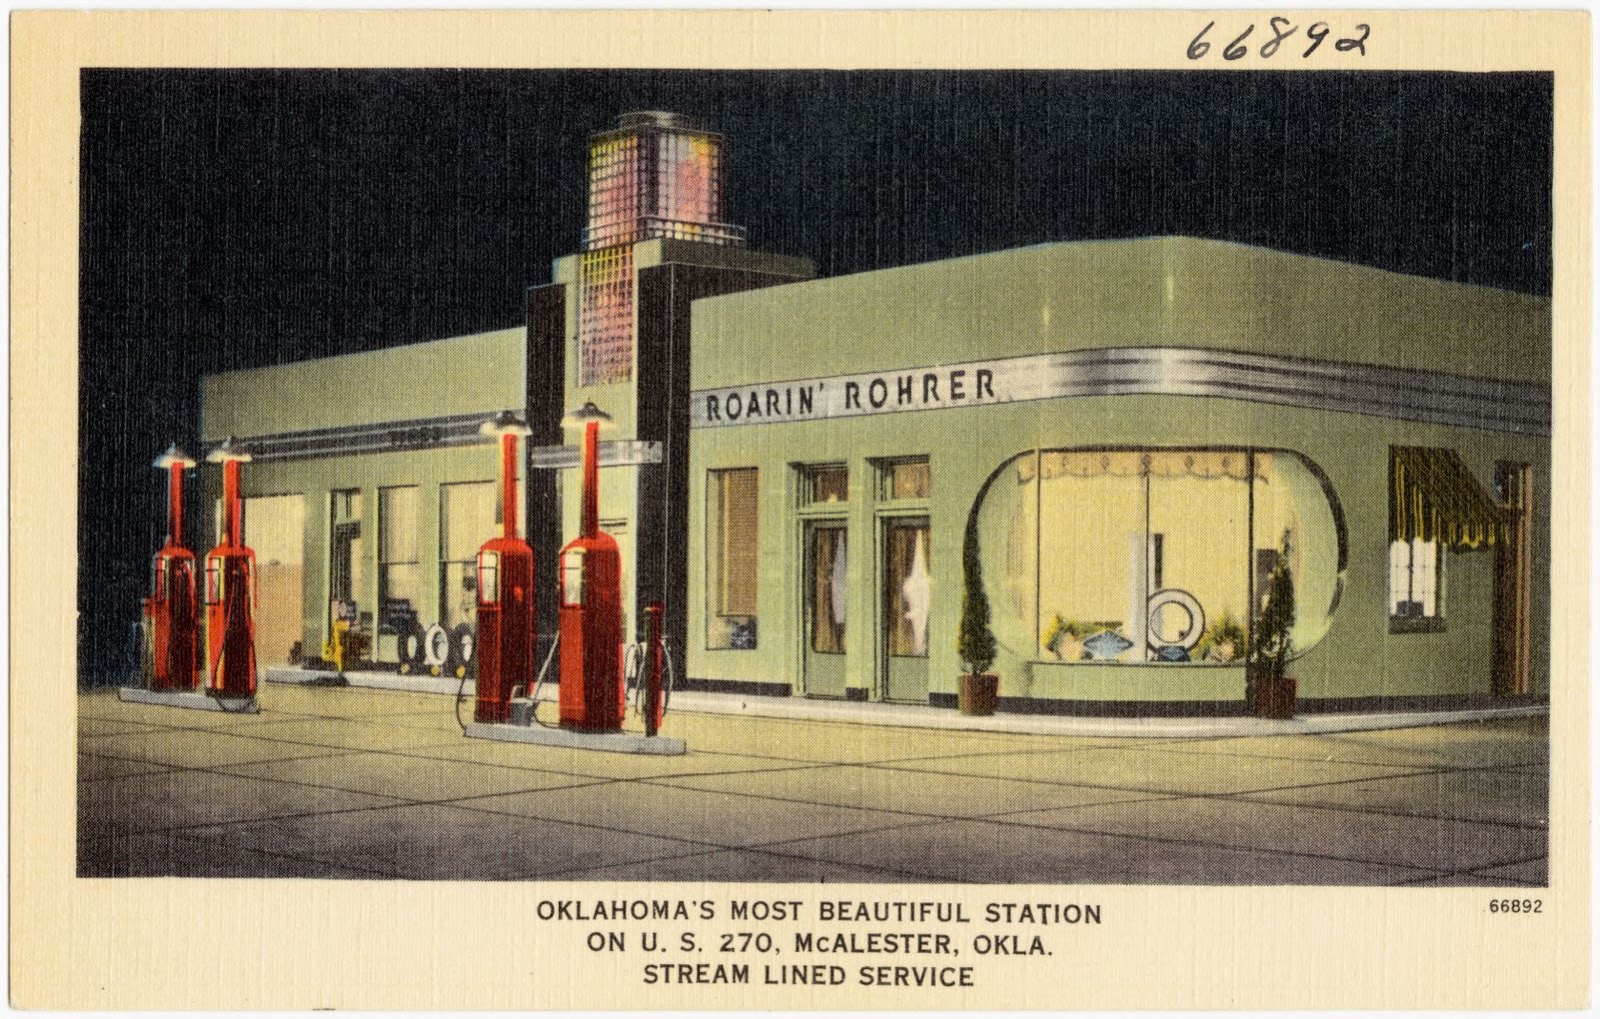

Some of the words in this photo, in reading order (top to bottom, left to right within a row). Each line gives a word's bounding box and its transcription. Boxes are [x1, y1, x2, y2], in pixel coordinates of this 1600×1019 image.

[1186, 16, 1371, 61] 66892
[705, 381, 824, 422] ROARIN'
[845, 368, 995, 410] ROHRER
[536, 900, 715, 921] OKLAHOMA'S
[731, 900, 803, 921] MOST
[819, 901, 970, 923] BEAUTIFUL
[985, 902, 1102, 925] STATION
[1489, 899, 1543, 913] 66892
[587, 931, 625, 952] ON
[641, 932, 667, 953] U.
[680, 932, 703, 953] S.
[719, 932, 780, 955] 270,
[795, 932, 959, 957] McALESTER,
[973, 934, 1054, 956] OKLA.
[643, 963, 749, 984] STREAM
[764, 964, 846, 986] LINED
[859, 965, 975, 987] SERVICE
